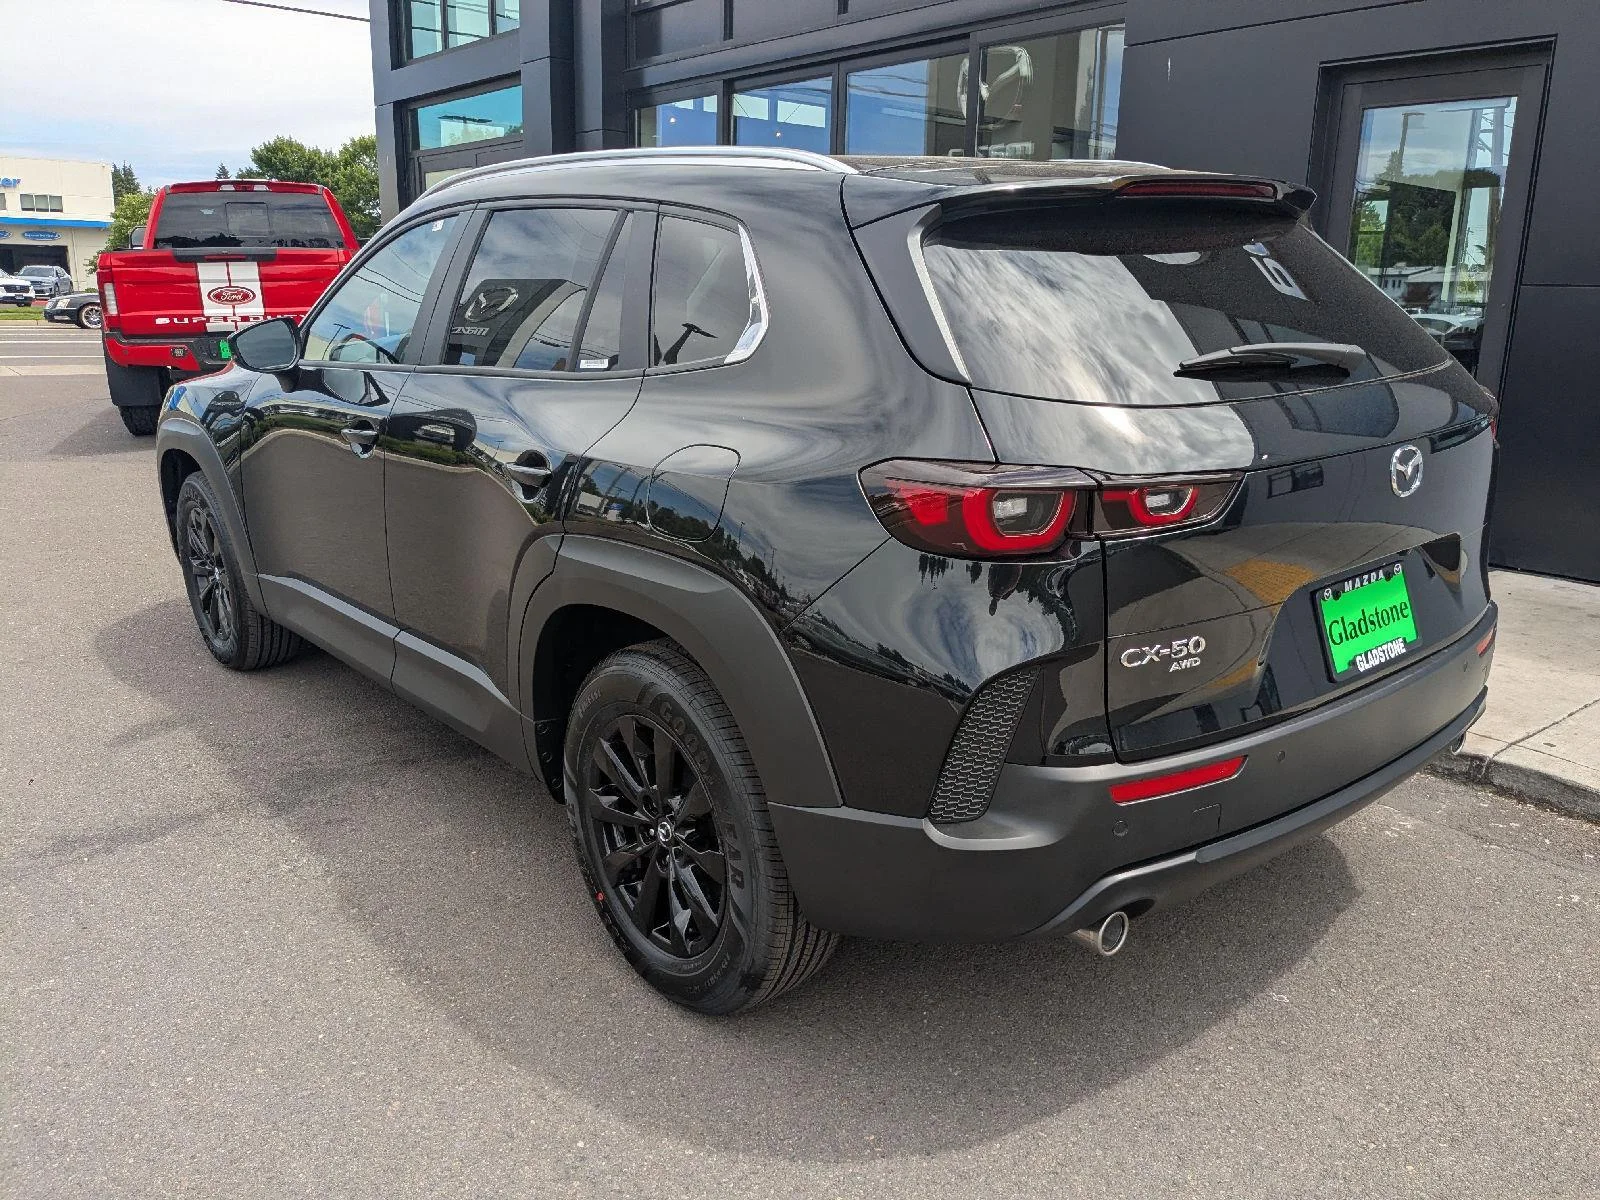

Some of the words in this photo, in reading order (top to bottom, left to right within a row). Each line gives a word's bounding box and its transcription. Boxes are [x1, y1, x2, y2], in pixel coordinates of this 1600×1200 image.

[220, 290, 244, 301] Ford
[155, 314, 241, 325] SUPER
[1344, 569, 1384, 593] MAZDA
[1328, 601, 1409, 646] Gladstone
[1120, 635, 1206, 668] CX-50
[1355, 637, 1406, 673] GLADSTONE
[1169, 656, 1201, 673] AWD
